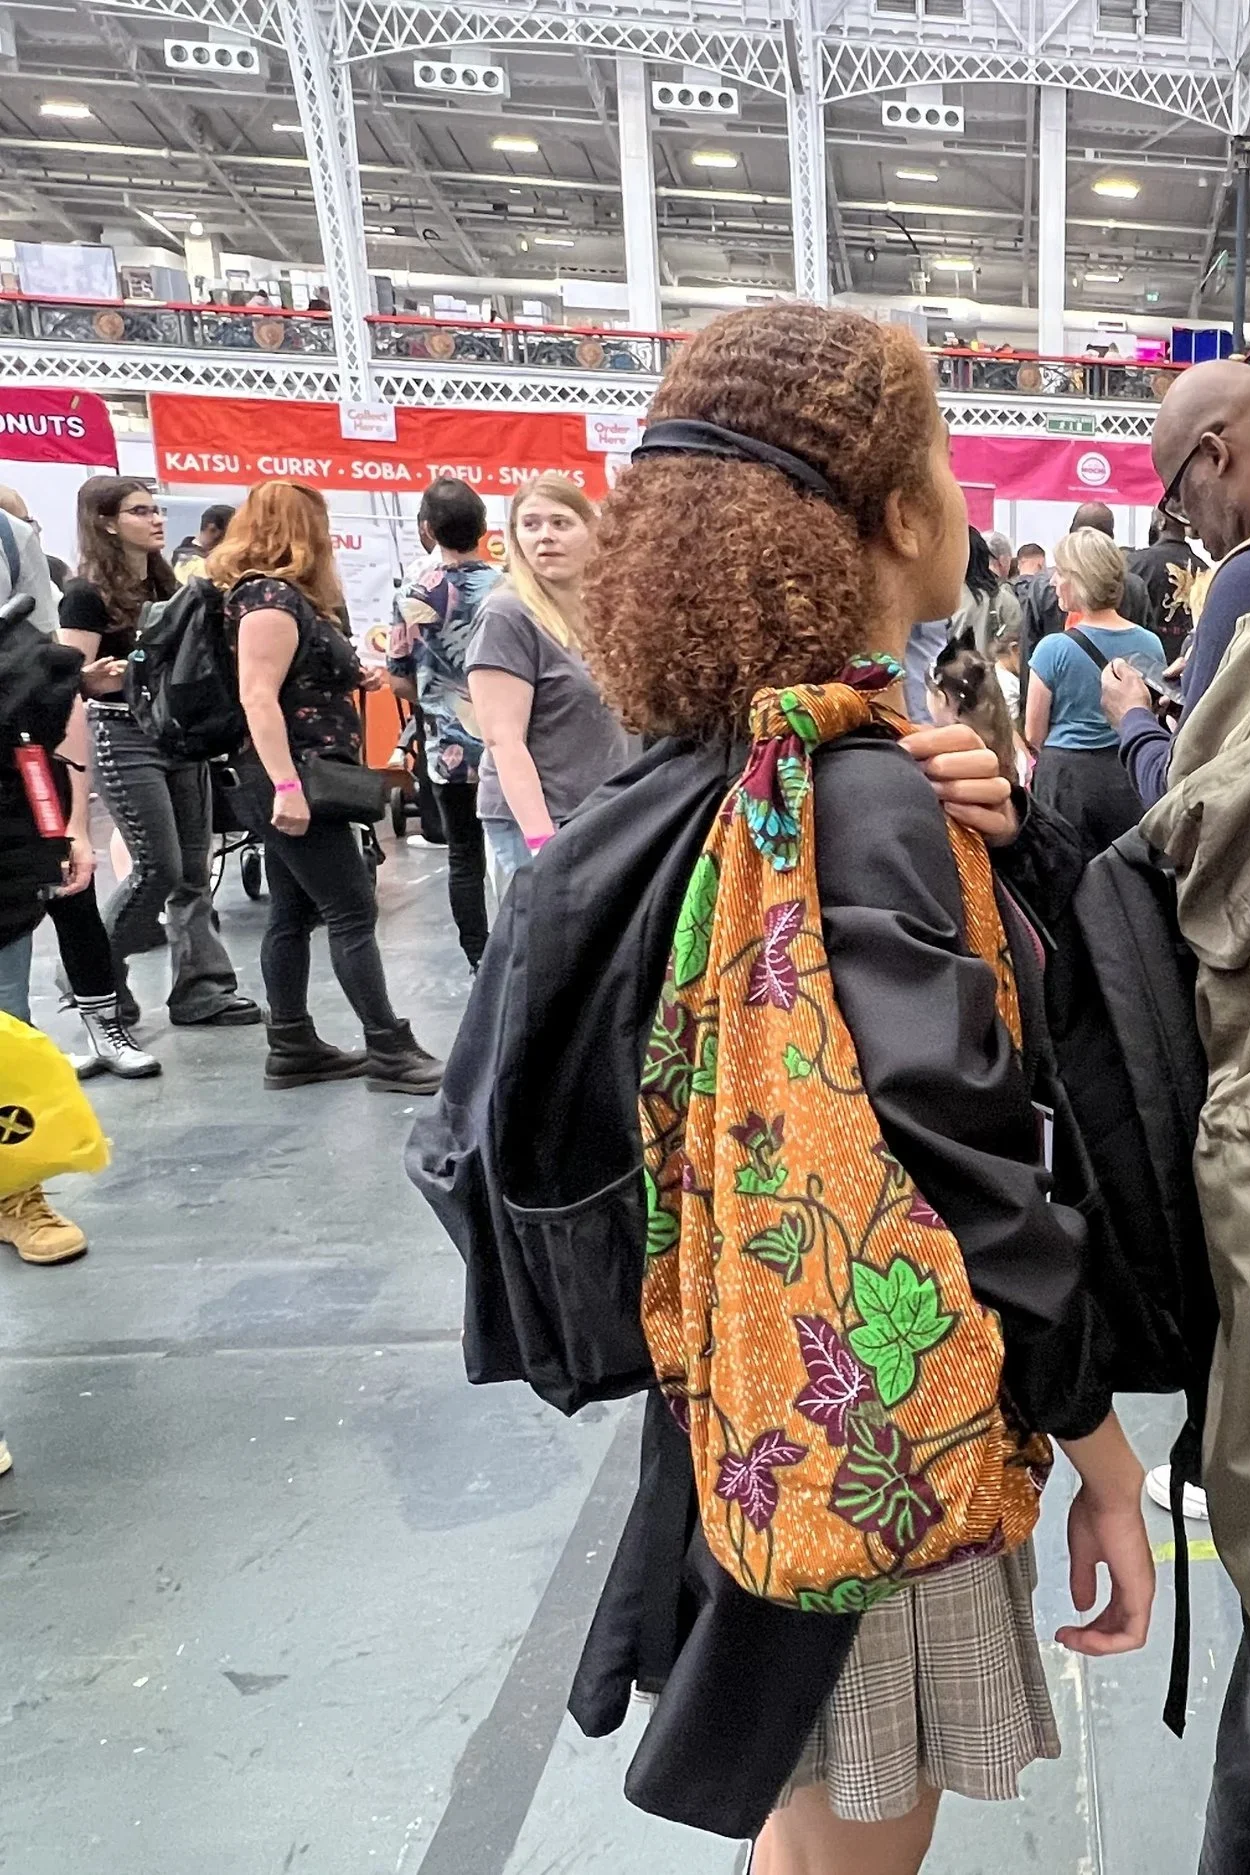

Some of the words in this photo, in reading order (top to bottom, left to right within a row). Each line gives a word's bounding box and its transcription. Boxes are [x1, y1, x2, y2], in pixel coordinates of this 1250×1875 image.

[594, 422, 631, 434] Order
[599, 433, 627, 445] Here
[165, 452, 240, 473] KATSU
[256, 456, 332, 478] CURRY
[350, 460, 412, 482] SOBA
